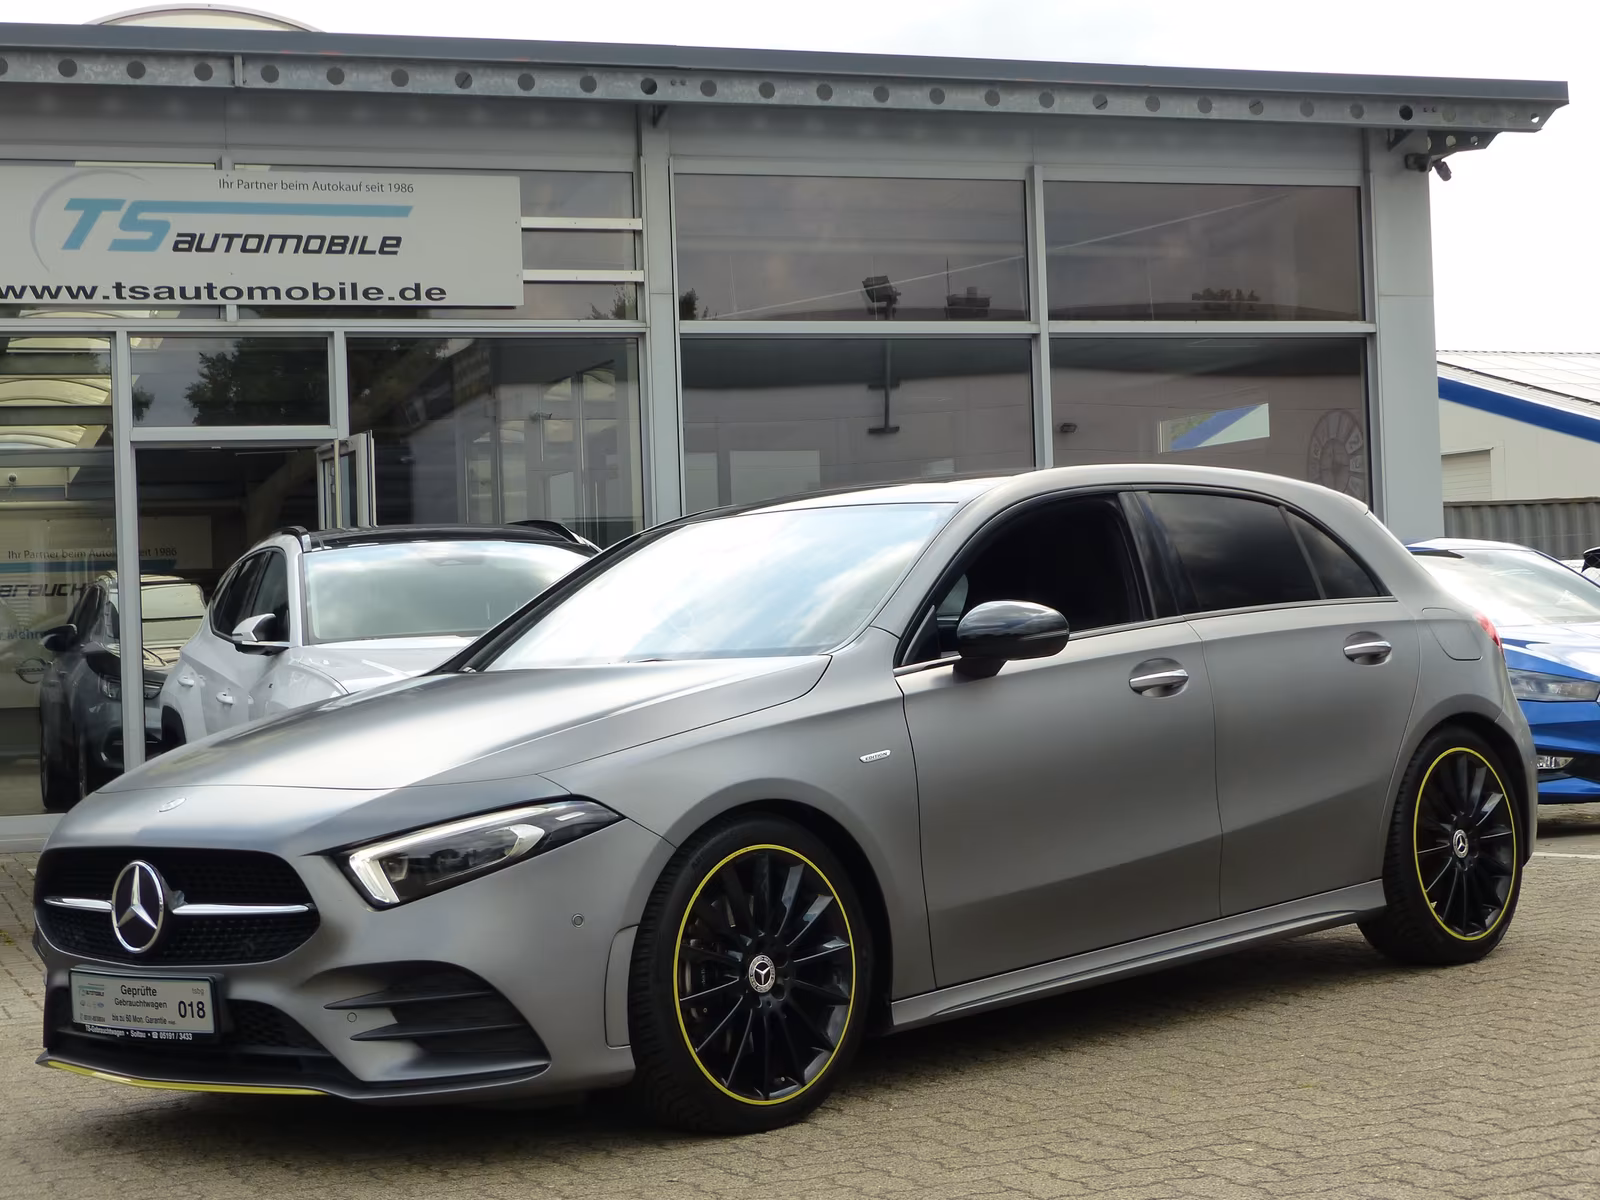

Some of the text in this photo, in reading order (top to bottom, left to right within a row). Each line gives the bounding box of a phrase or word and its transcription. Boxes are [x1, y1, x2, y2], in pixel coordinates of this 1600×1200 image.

[218, 178, 414, 193] Ihr Partner beim Autokauf seit 1986
[61, 198, 171, 252] TS
[0, 282, 447, 302] www.tsautomobile.de
[8, 550, 21, 560] Ihr
[24, 550, 59, 559] Partner
[62, 549, 86, 559] beim
[89, 548, 118, 558] Auto
[155, 547, 177, 557] 1986
[120, 984, 158, 998] Geprüfte
[114, 997, 168, 1010] Gebrauchtwagen
[178, 1000, 206, 1019] 018
[145, 1016, 167, 1025] Garantie
[179, 1033, 193, 1041] 3433
